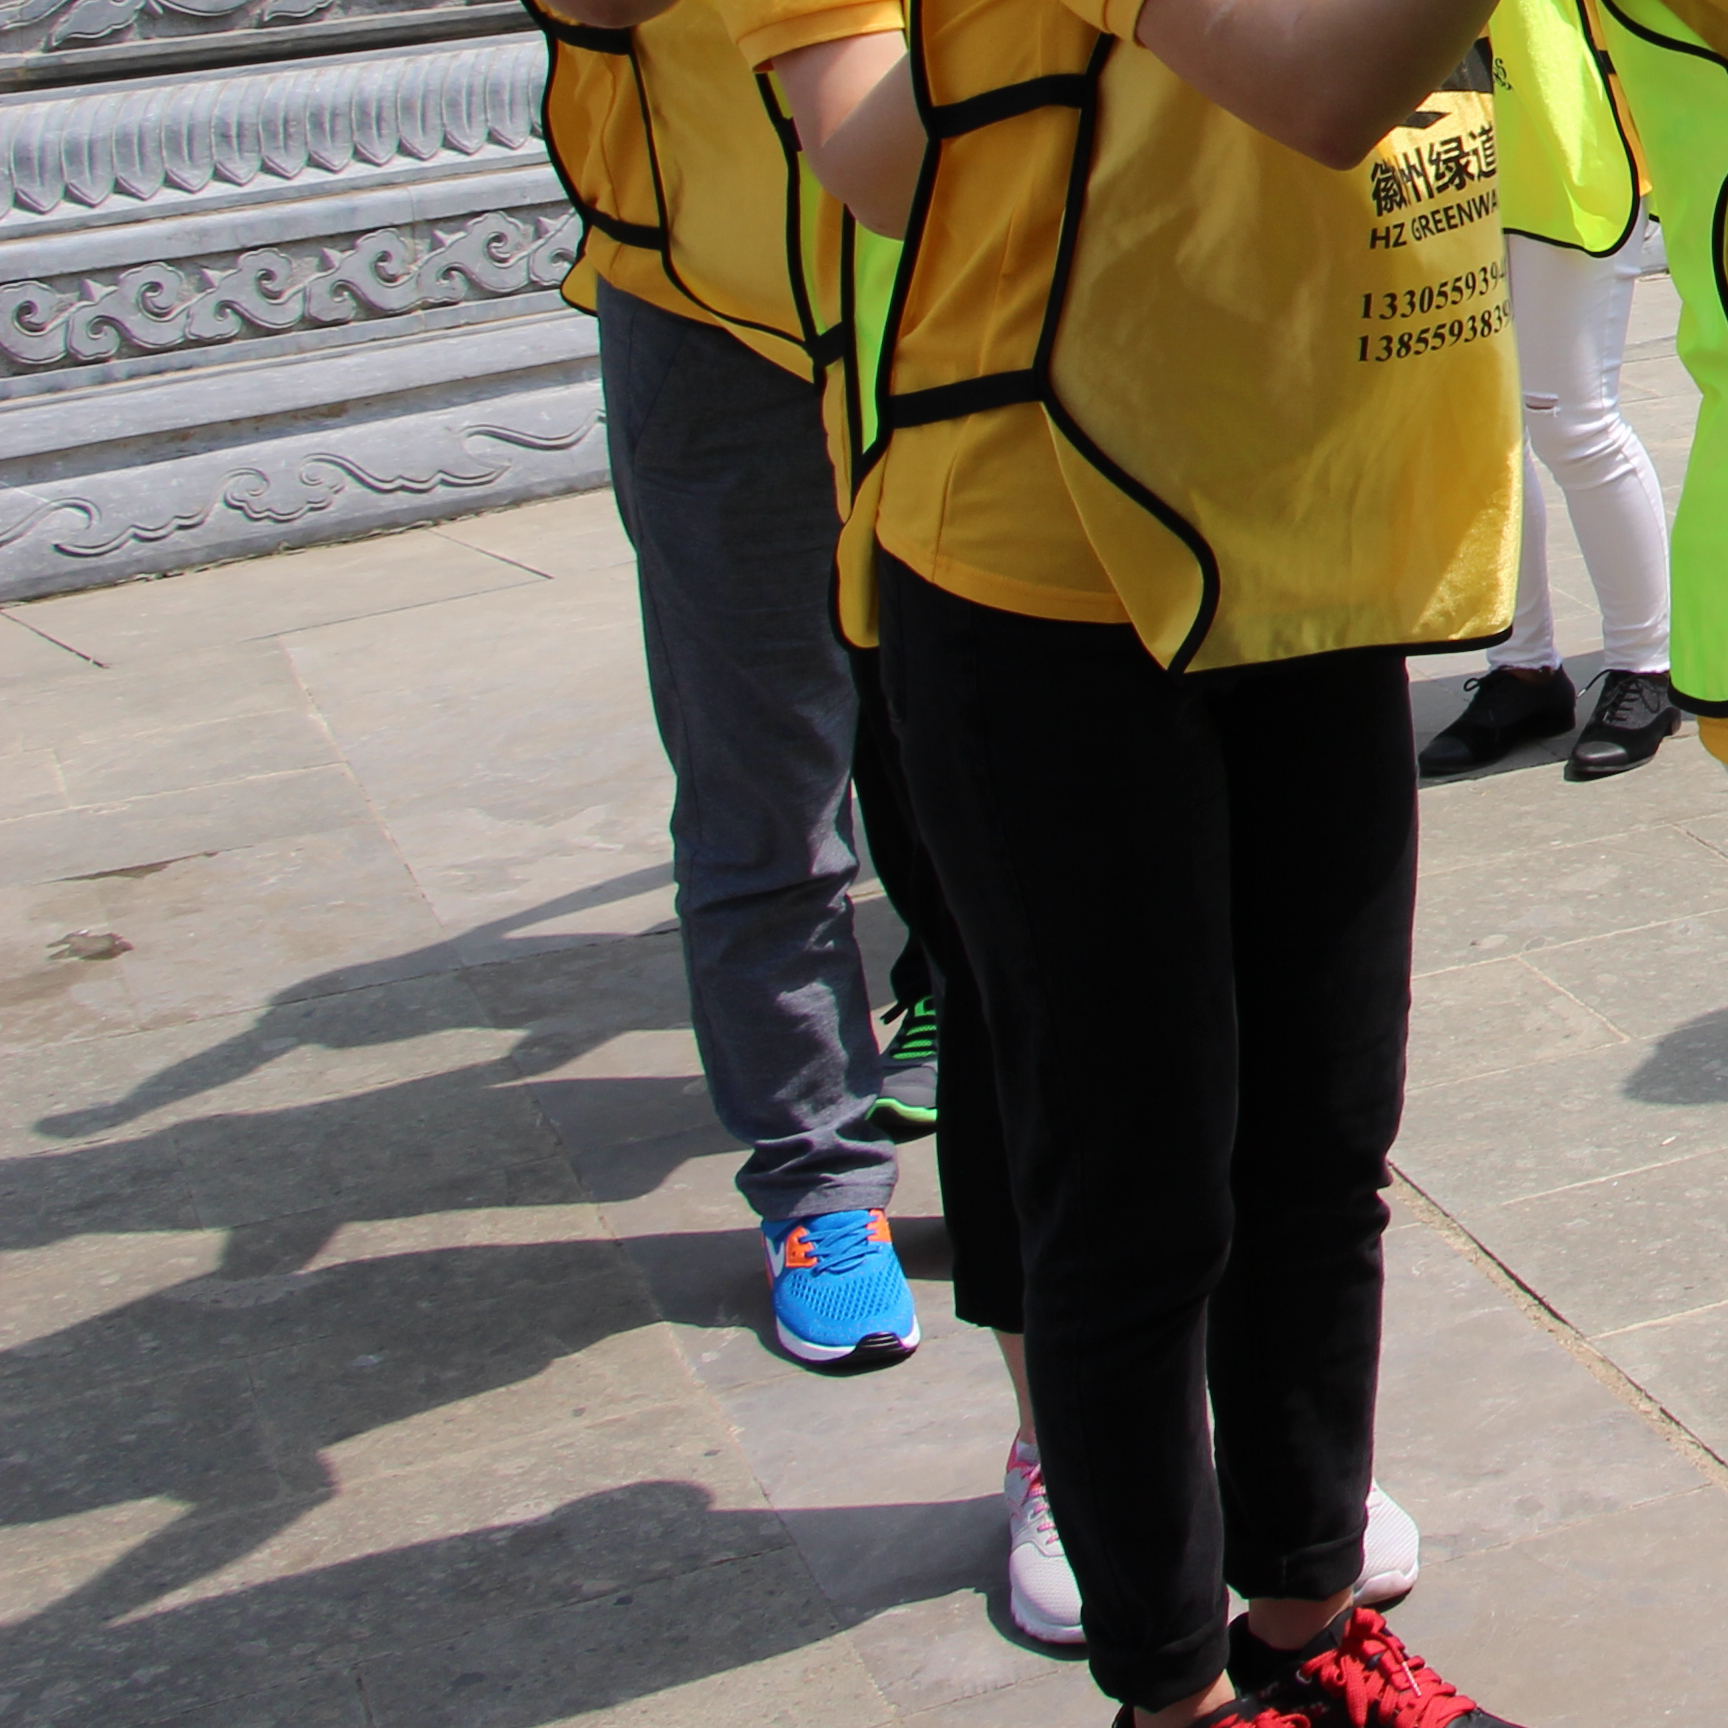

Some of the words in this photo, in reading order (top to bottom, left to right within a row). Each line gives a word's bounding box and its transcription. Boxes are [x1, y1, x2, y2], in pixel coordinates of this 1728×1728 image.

[1370, 121, 1497, 217] 徽州绿道
[1369, 221, 1408, 249] HZ
[1410, 189, 1497, 241] GREENWA
